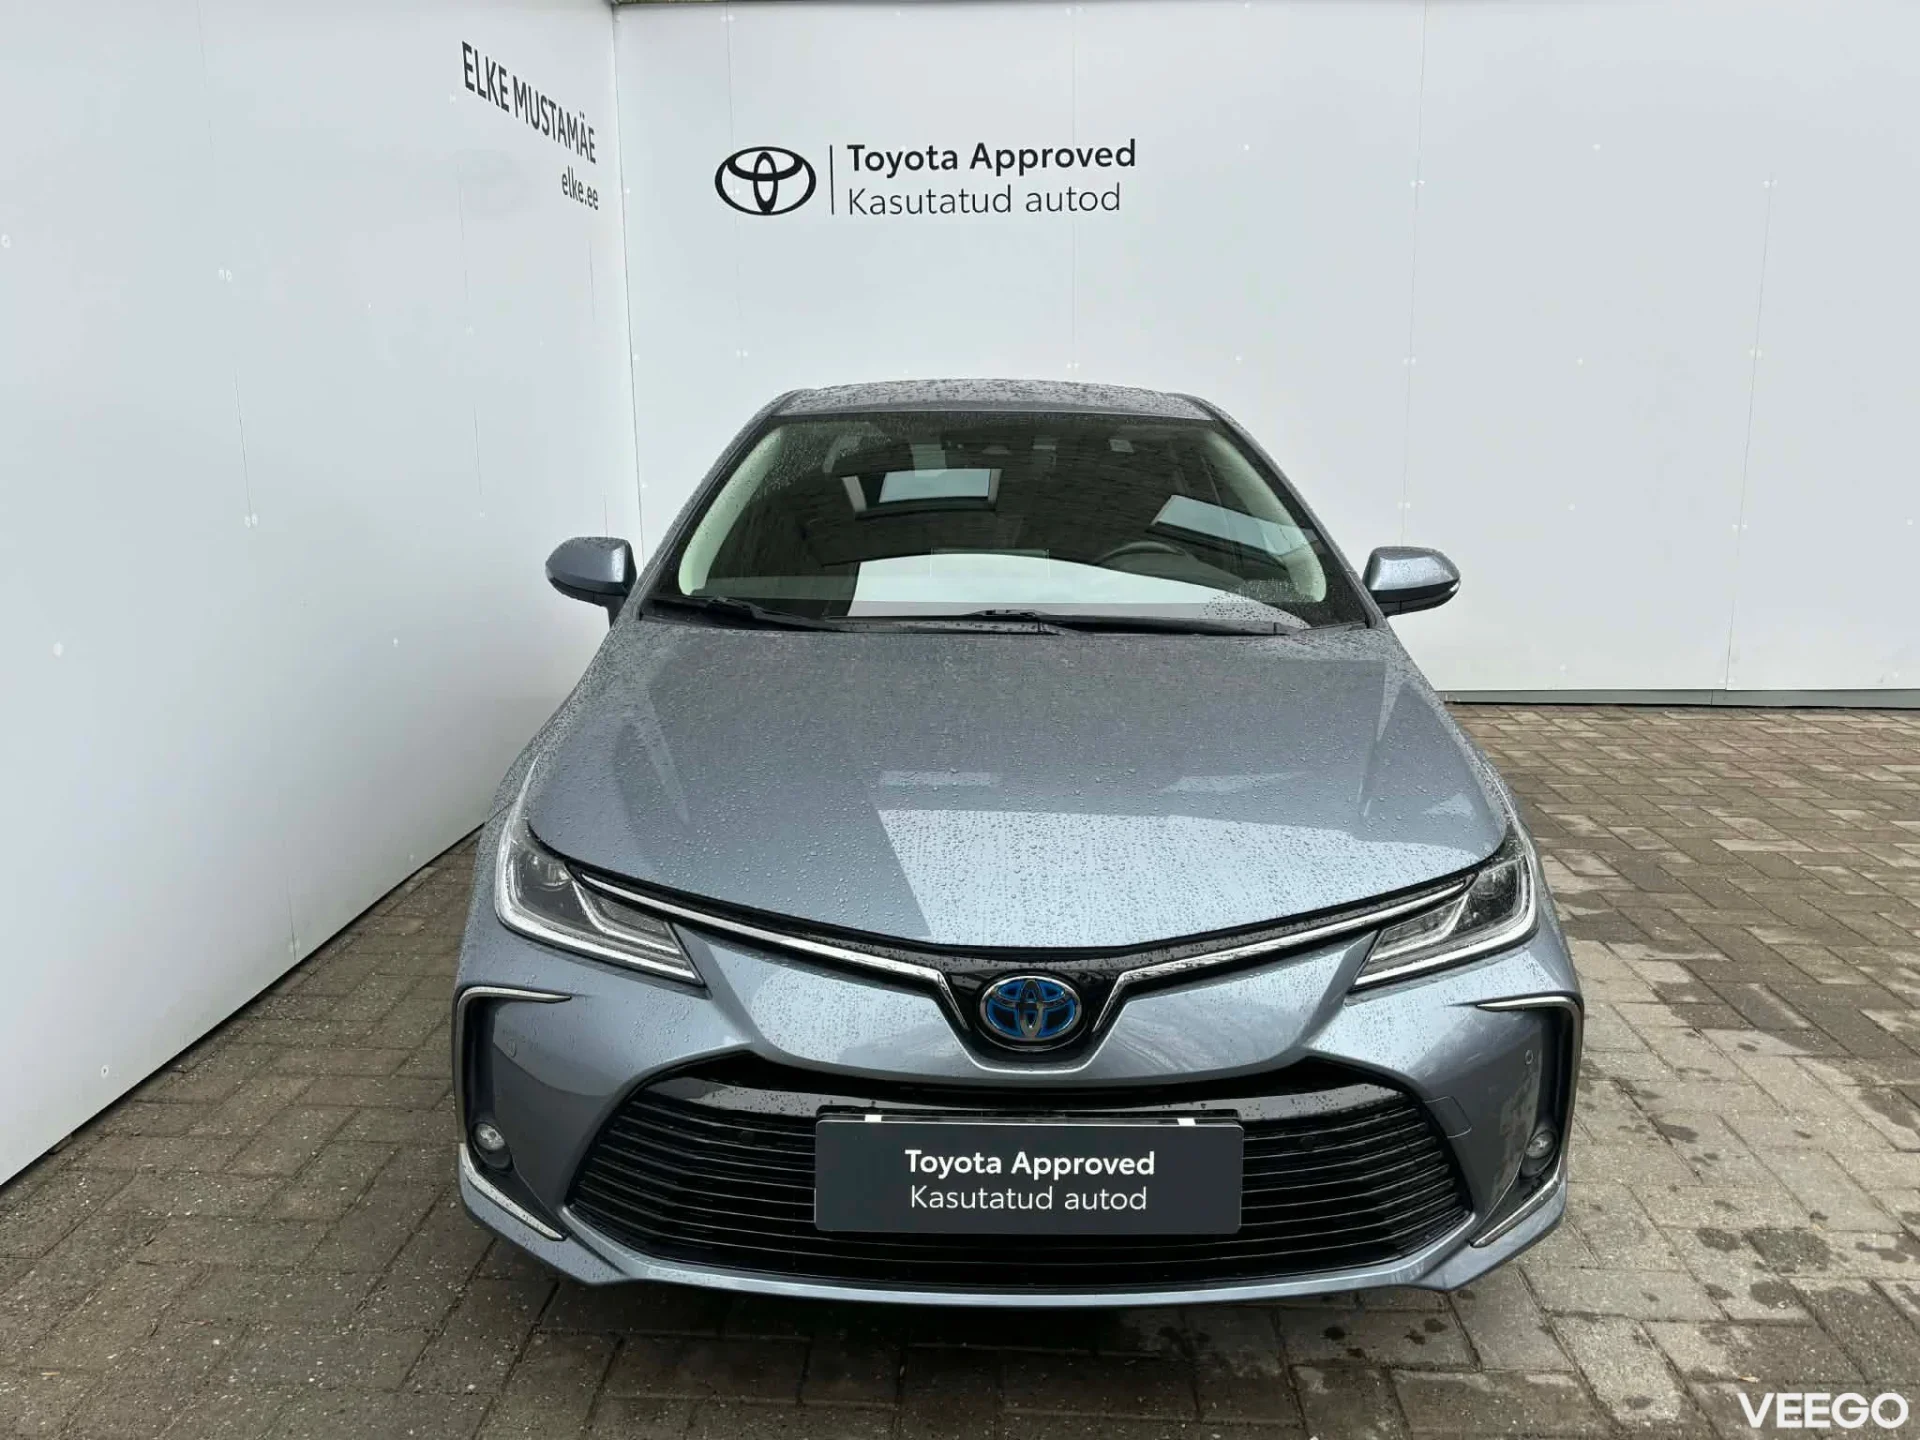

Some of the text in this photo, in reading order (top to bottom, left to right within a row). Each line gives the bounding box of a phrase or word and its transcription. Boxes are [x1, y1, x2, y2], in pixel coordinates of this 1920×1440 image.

[462, 41, 597, 164] ELKE MUSTAMÄE
[846, 138, 1136, 179] Toyota Approved
[561, 165, 599, 211] elke.ee
[849, 182, 1120, 215] Kasutatud autod
[904, 1149, 1155, 1181] Toyota Approved
[911, 1184, 1147, 1210] Kasutatud autod
